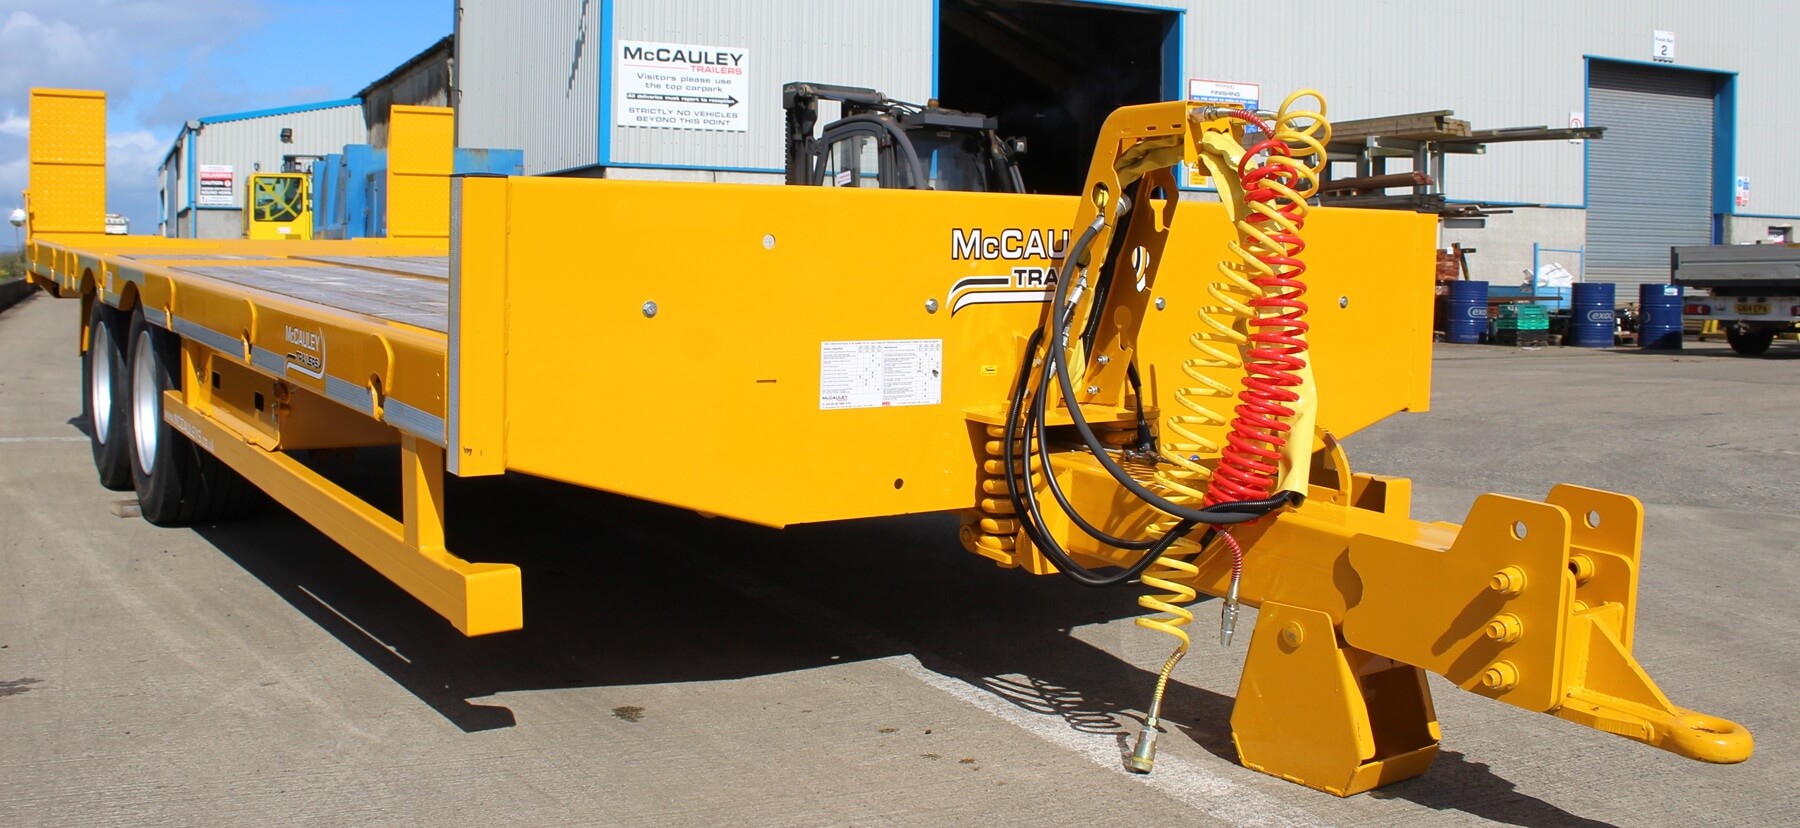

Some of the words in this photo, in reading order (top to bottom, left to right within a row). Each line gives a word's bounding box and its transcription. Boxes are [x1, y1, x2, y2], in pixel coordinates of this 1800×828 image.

[623, 46, 743, 66] McCAULEY
[1661, 45, 1668, 56] 2
[691, 65, 743, 76] TRAILERS
[637, 73, 677, 82] Visitors
[680, 75, 711, 84] please
[665, 83, 682, 91] top
[685, 85, 723, 93] carpark
[628, 107, 674, 116] STRICTLY
[693, 110, 738, 119] VEHICLES
[636, 115, 677, 123] BEYOND
[951, 228, 1070, 260] McCAU
